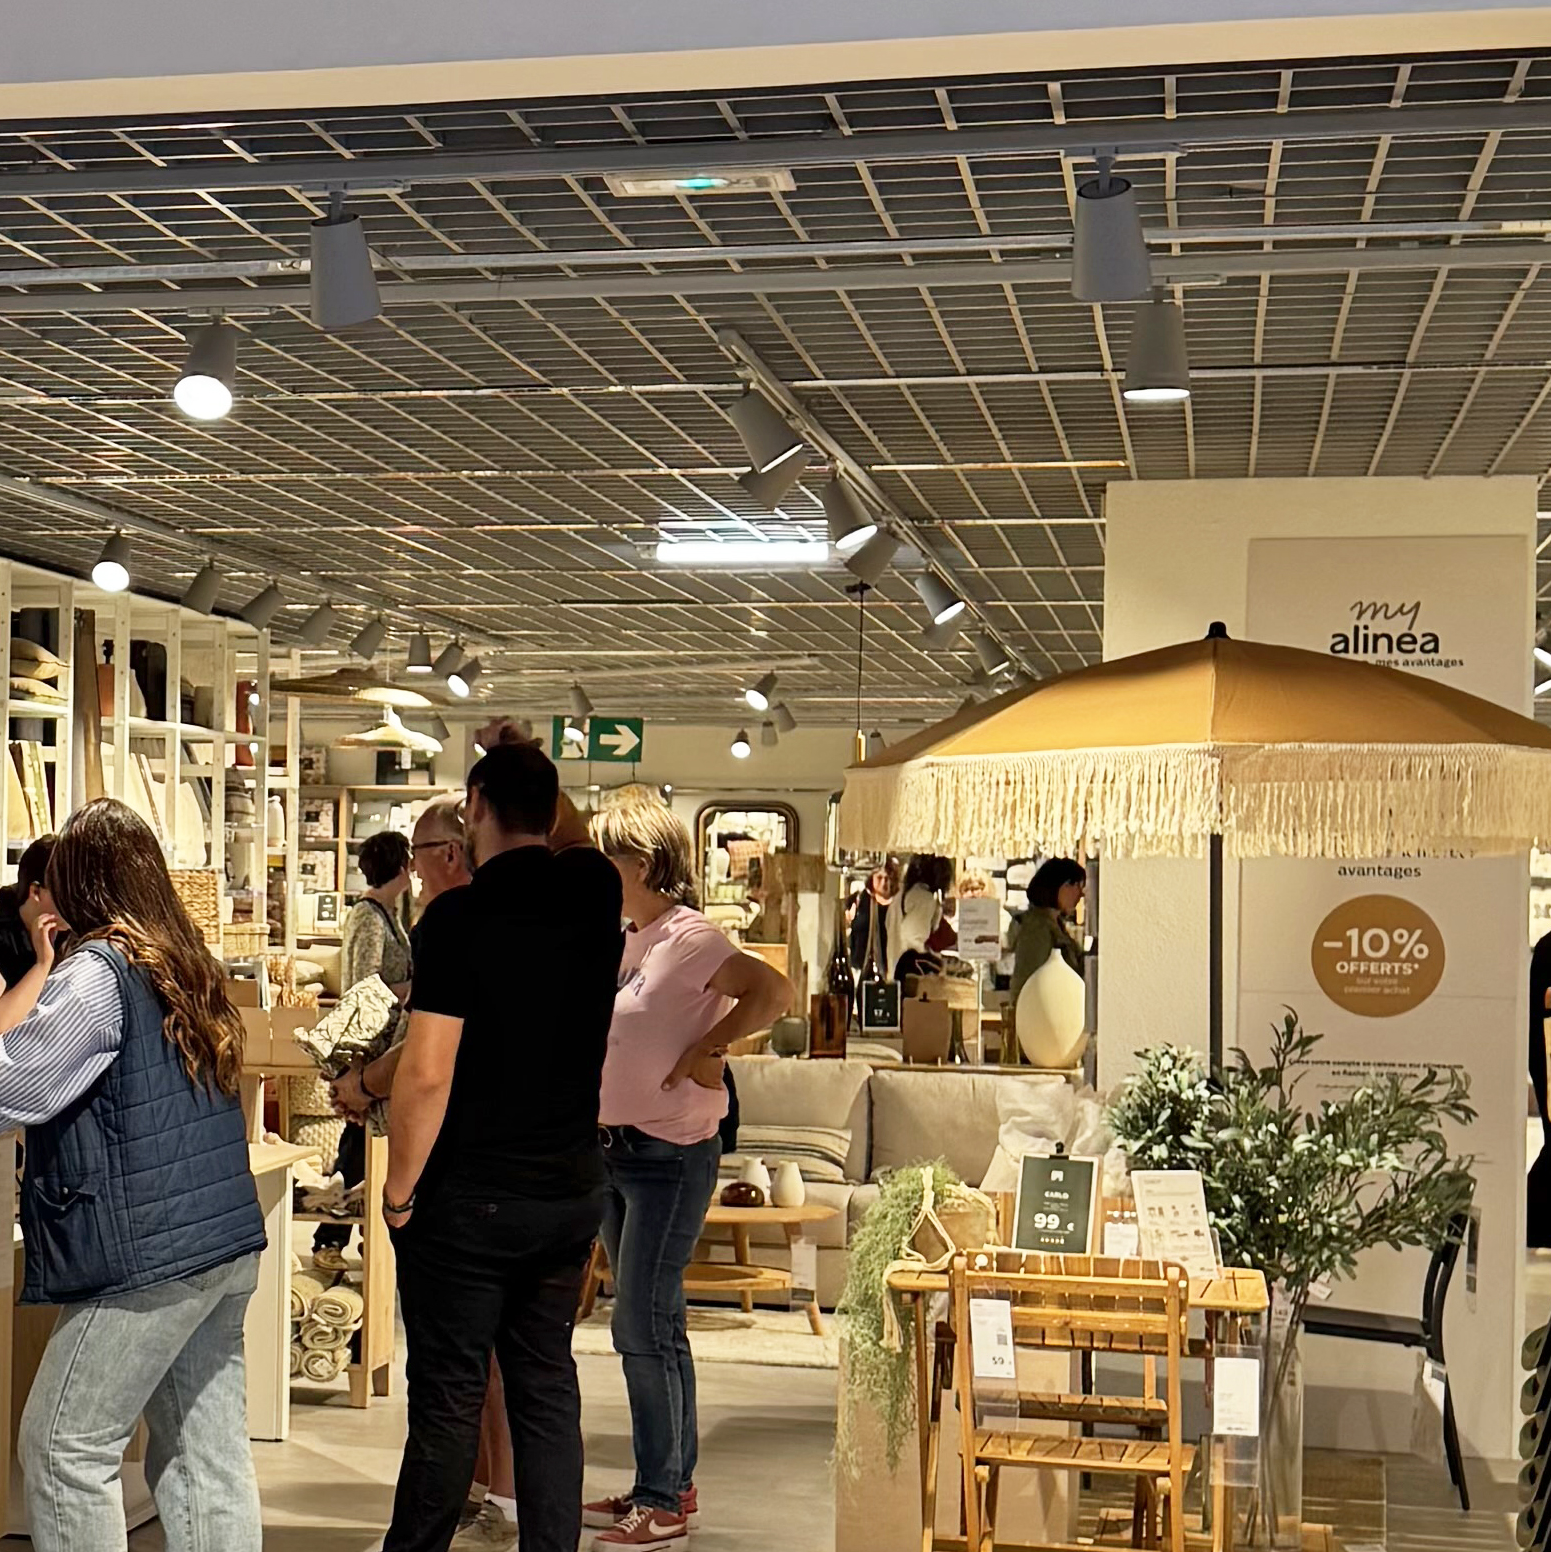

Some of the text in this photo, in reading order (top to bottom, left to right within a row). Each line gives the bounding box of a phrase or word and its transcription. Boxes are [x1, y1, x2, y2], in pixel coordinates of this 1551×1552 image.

[1350, 600, 1422, 631] my
[1329, 624, 1440, 654] alinea
[1402, 658, 1464, 669] avantages
[1338, 864, 1422, 879] avantages
[1322, 927, 1430, 960] -10%
[1034, 1212, 1060, 1230] 99
